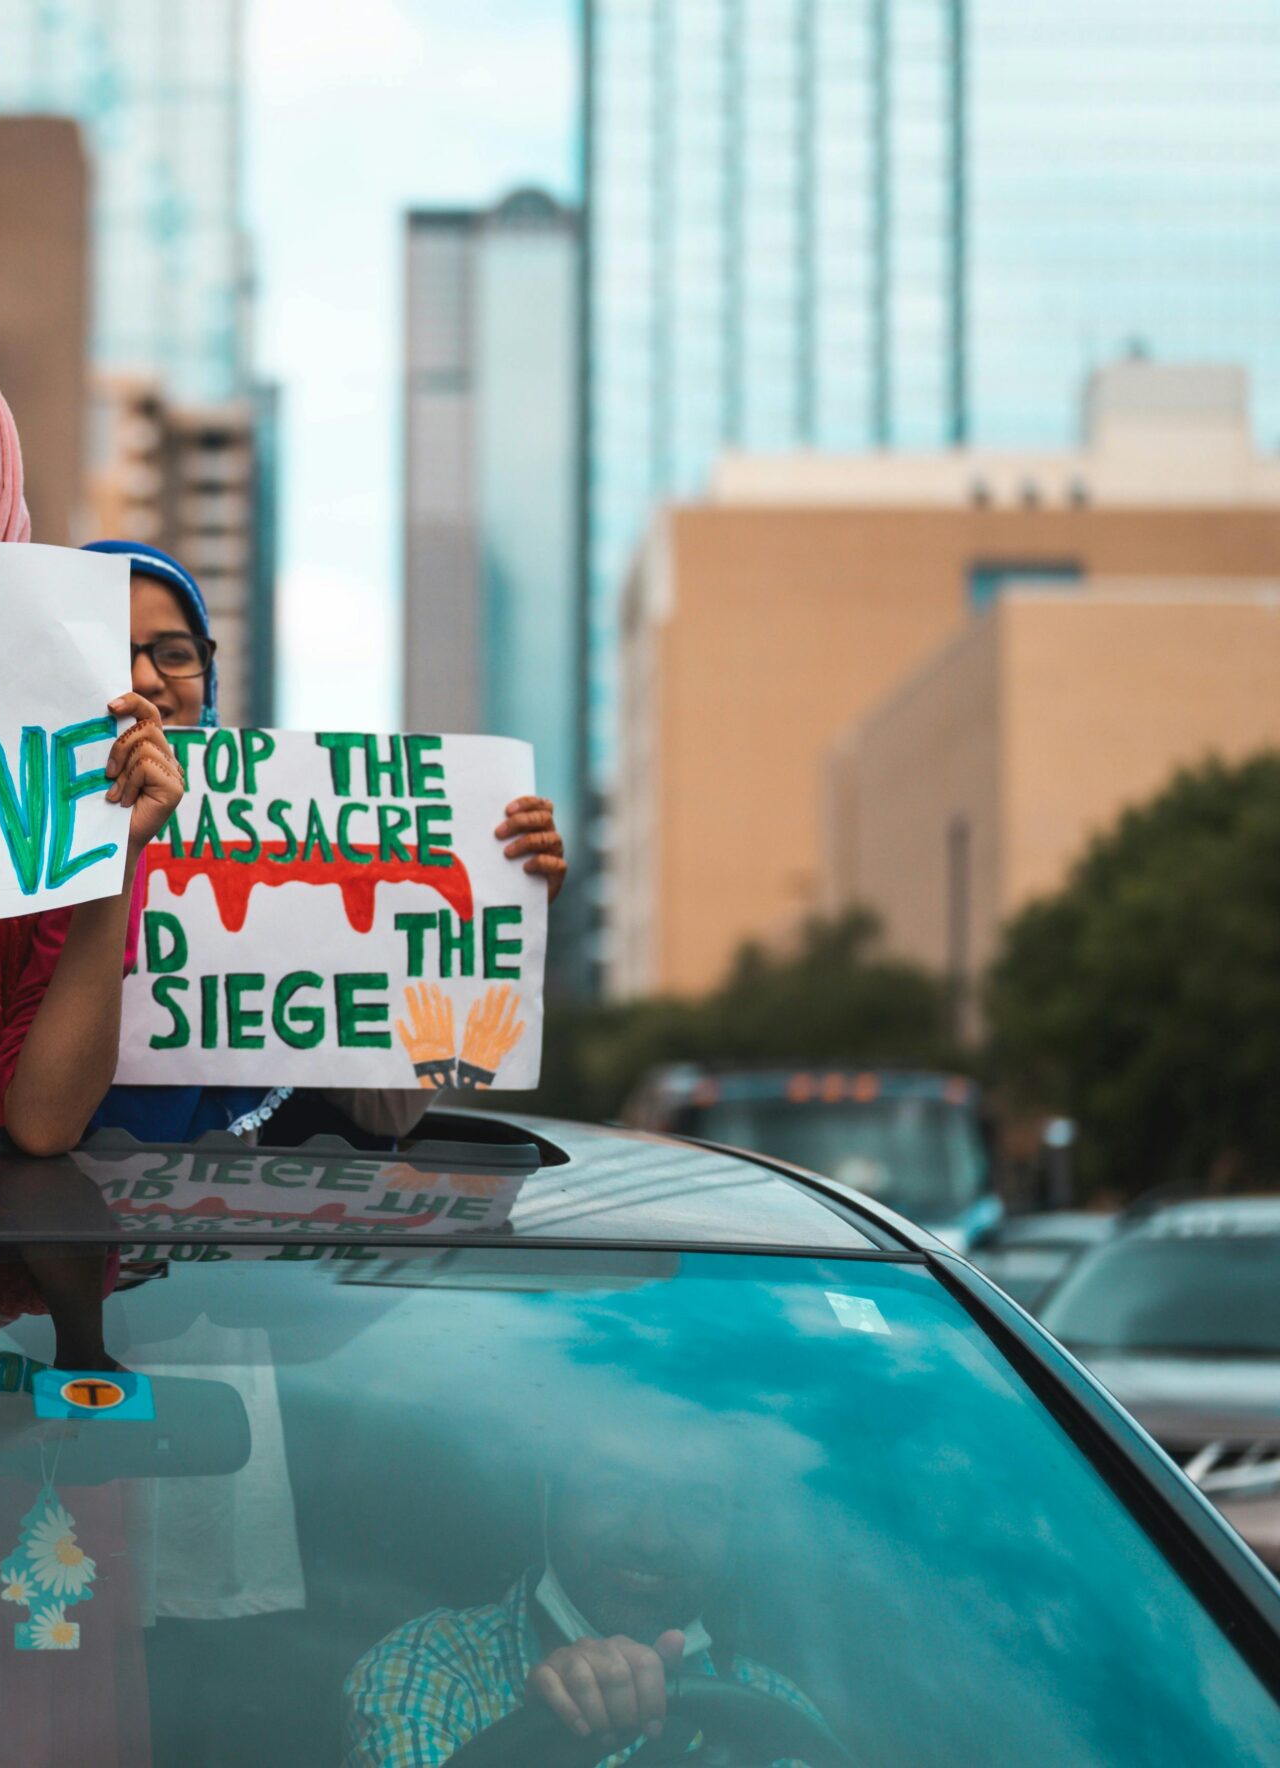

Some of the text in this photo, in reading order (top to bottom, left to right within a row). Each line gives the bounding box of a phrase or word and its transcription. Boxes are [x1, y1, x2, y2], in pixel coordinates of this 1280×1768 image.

[163, 727, 446, 799] TOP THE
[394, 905, 524, 981] THE
[148, 970, 392, 1050] SIEGE
